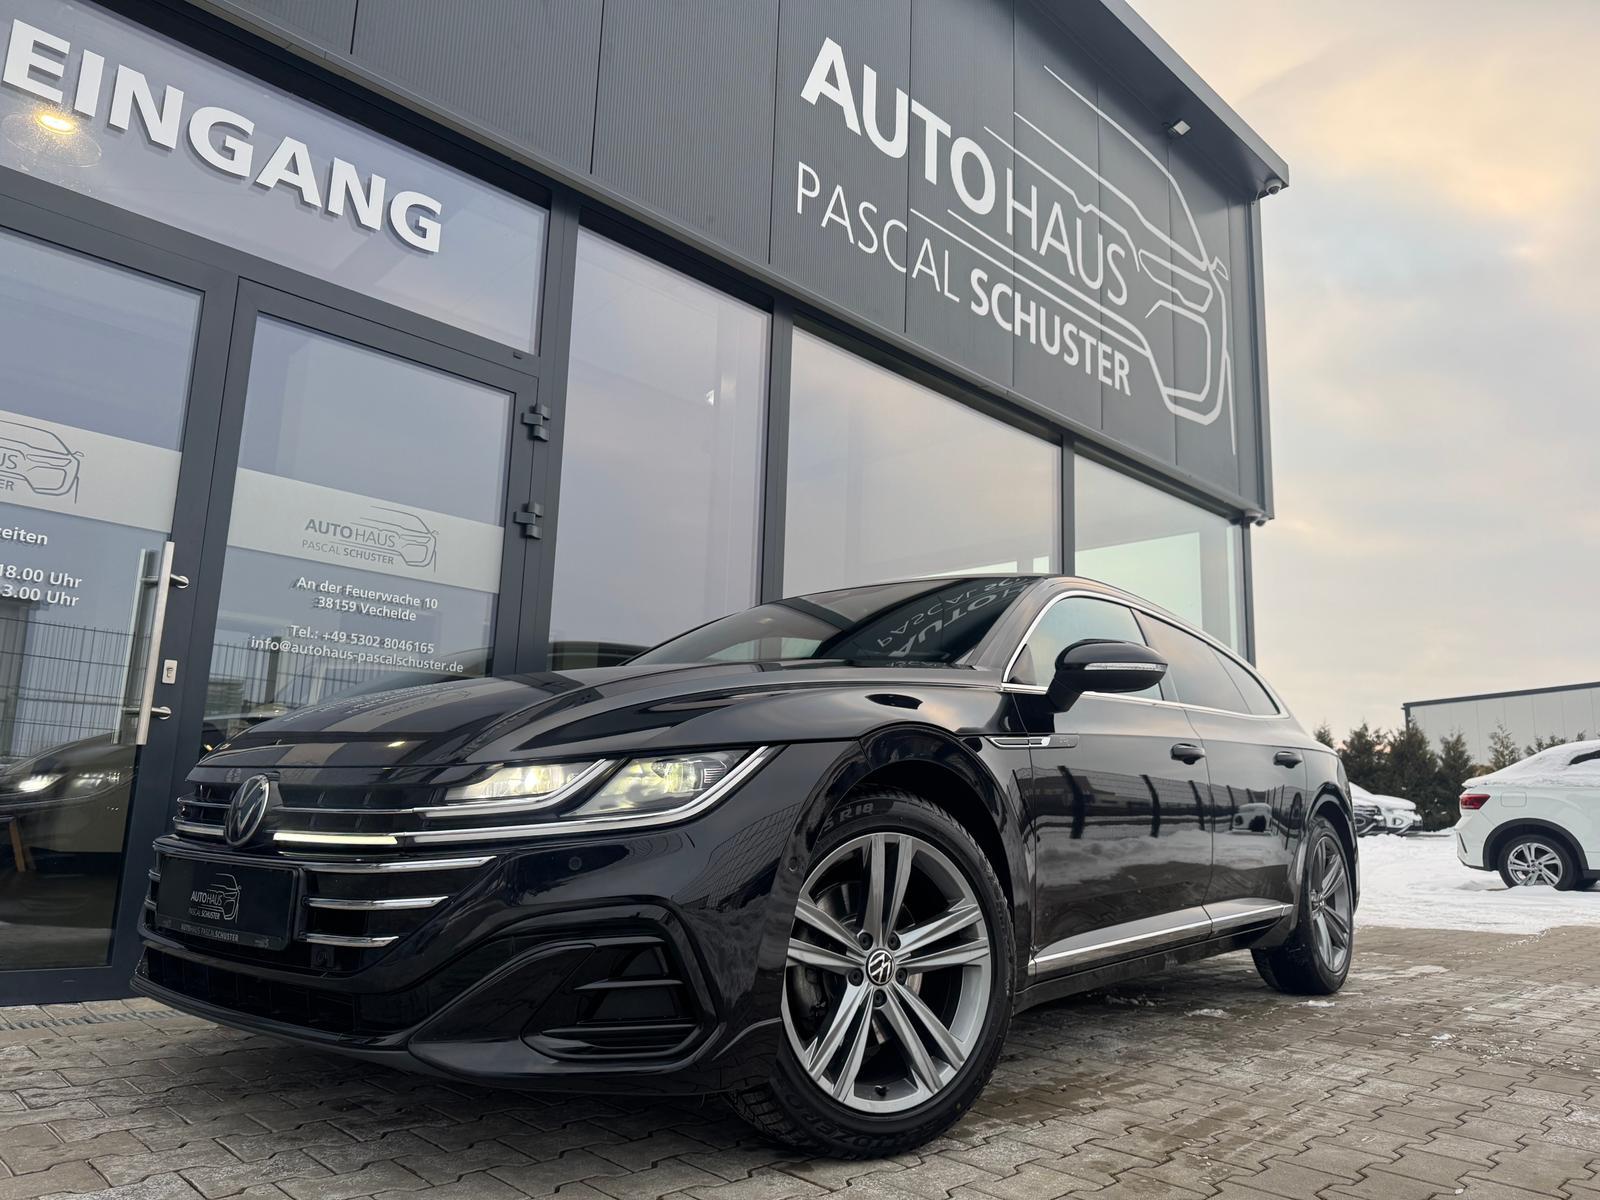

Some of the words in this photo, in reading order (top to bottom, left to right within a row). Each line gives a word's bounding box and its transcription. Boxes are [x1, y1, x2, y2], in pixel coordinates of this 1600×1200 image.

[3, 18, 443, 253] EINGANG
[800, 37, 1129, 306] AUTOHAUS
[797, 161, 960, 304] PASCAL
[970, 268, 1131, 396] SCHUSTER
[0, 526, 48, 545] eiten
[304, 519, 396, 548] AUTOHAUS
[302, 539, 341, 555] PASCAL
[343, 547, 395, 565] SCHUSTER
[50, 571, 82, 588] Uhr
[297, 576, 316, 590] An
[320, 580, 342, 594] der
[345, 585, 421, 607] Feuerwache
[424, 598, 438, 609] 10
[46, 590, 79, 606] Uhr
[318, 596, 356, 612] 38159
[360, 602, 417, 621] Vechelde
[291, 624, 319, 639] Tel.:
[322, 630, 347, 642] +49
[350, 633, 380, 648] 5302
[384, 637, 434, 654] 8046165
[251, 636, 464, 674] info@autohaus-pascalschuster.de
